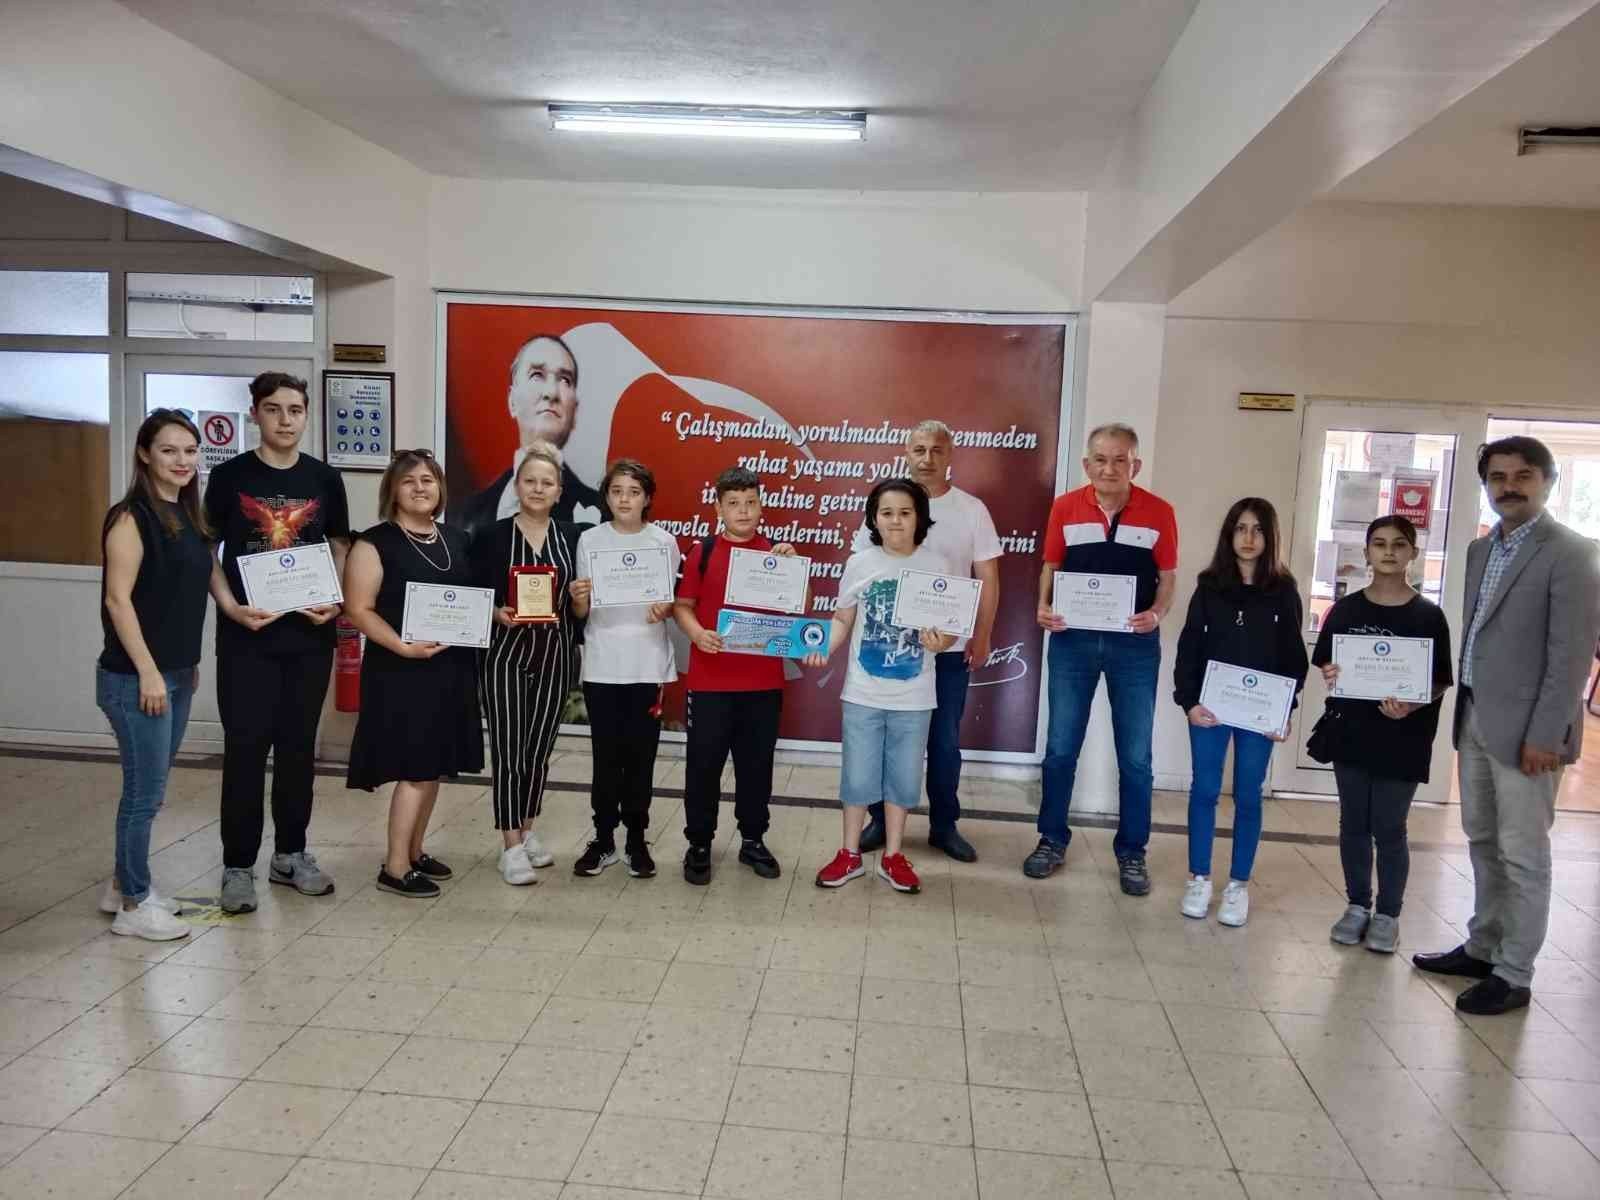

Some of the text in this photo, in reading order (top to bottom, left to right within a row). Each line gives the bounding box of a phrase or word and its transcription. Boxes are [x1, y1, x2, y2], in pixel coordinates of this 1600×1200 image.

[737, 450, 788, 473] rahat
[790, 457, 865, 483] yaşama
[758, 484, 815, 509] haline
